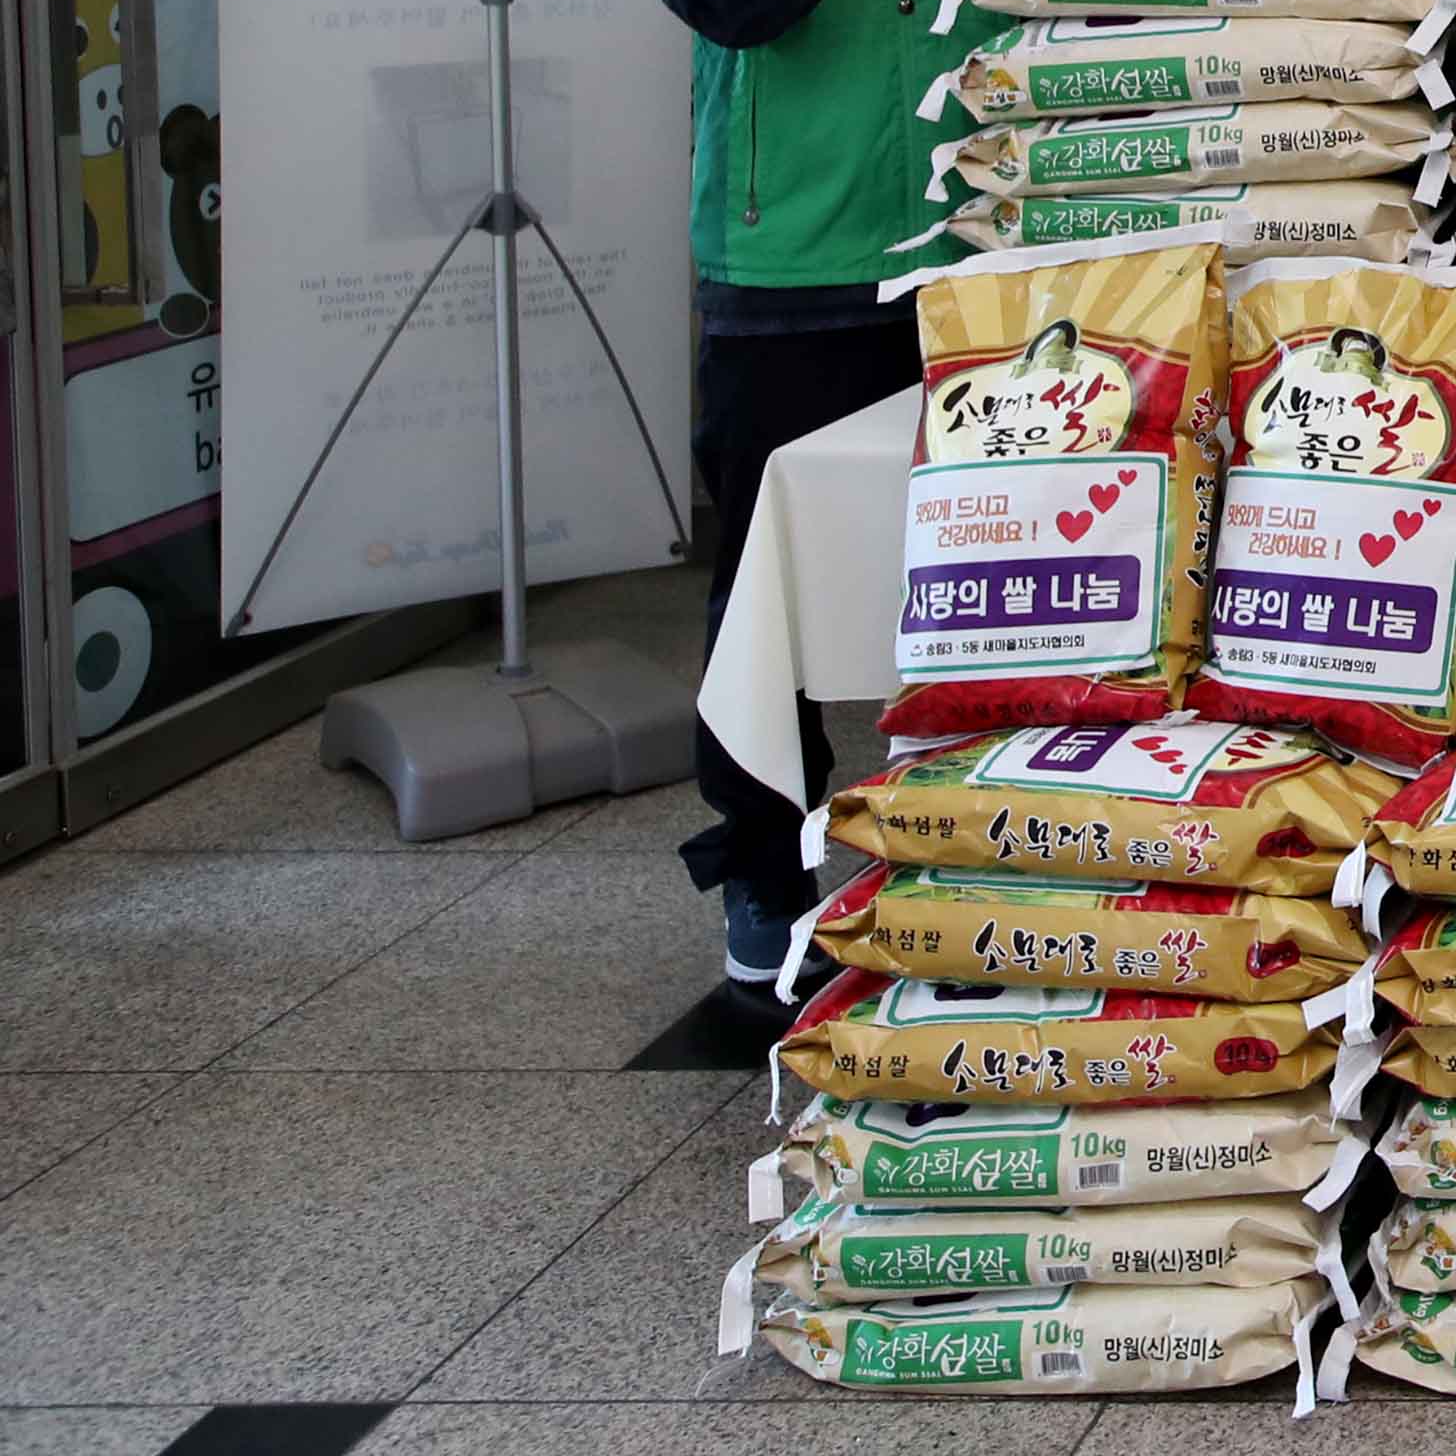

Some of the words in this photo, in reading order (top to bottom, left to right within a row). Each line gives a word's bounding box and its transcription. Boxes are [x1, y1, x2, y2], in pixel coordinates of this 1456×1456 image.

[983, 427, 1050, 458] 좋은
[1296, 431, 1363, 472] 좋은
[909, 576, 989, 621] 사랑의
[1001, 578, 1038, 615] 쌀
[1050, 572, 1122, 614] 나눔
[1211, 583, 1290, 629] 사랑의
[1301, 597, 1336, 632] 쌀
[1346, 597, 1418, 640] 나눔
[1113, 947, 1161, 976] 좋은
[1070, 1131, 1127, 1159] 10kg
